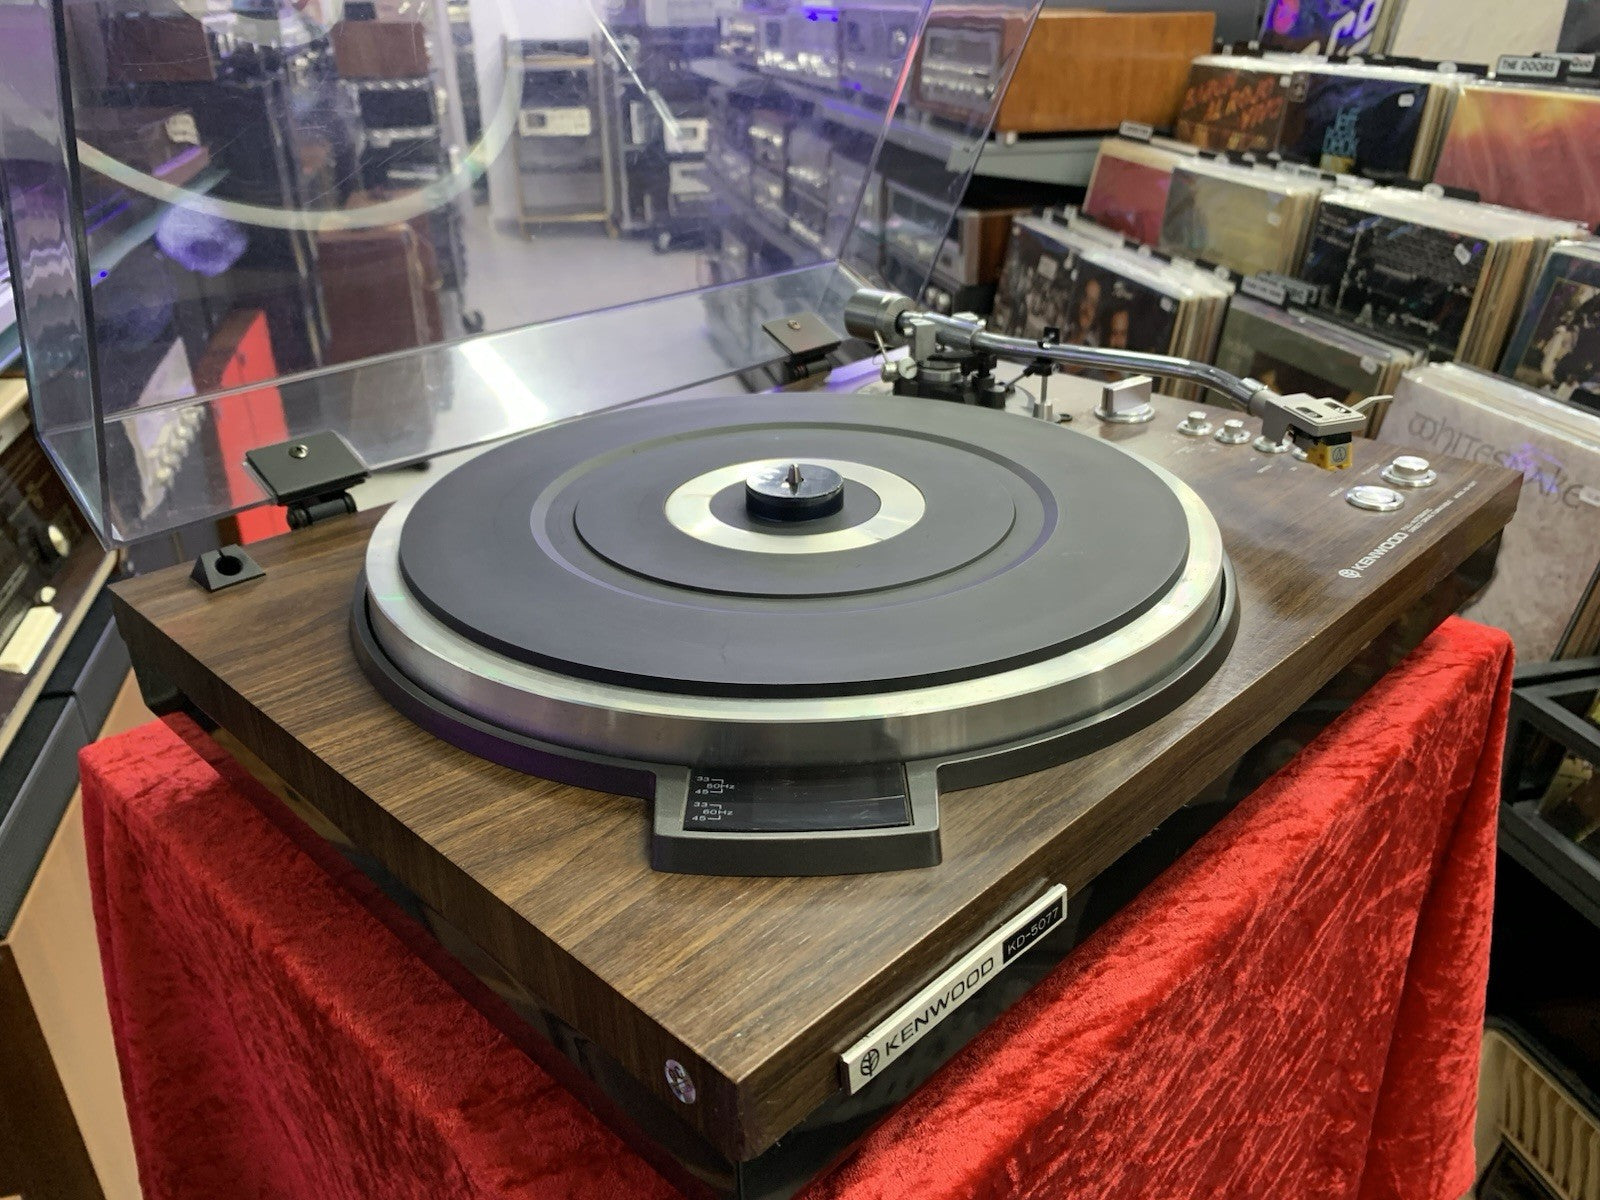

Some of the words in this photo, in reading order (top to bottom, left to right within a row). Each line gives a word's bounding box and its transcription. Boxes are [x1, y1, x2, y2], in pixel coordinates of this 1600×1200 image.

[1502, 59, 1519, 70] THE
[1520, 60, 1555, 72] DOORS
[1351, 532, 1409, 571] KENWOOD
[885, 957, 994, 1057] KENWOOD
[1007, 906, 1059, 955] KD-5077
